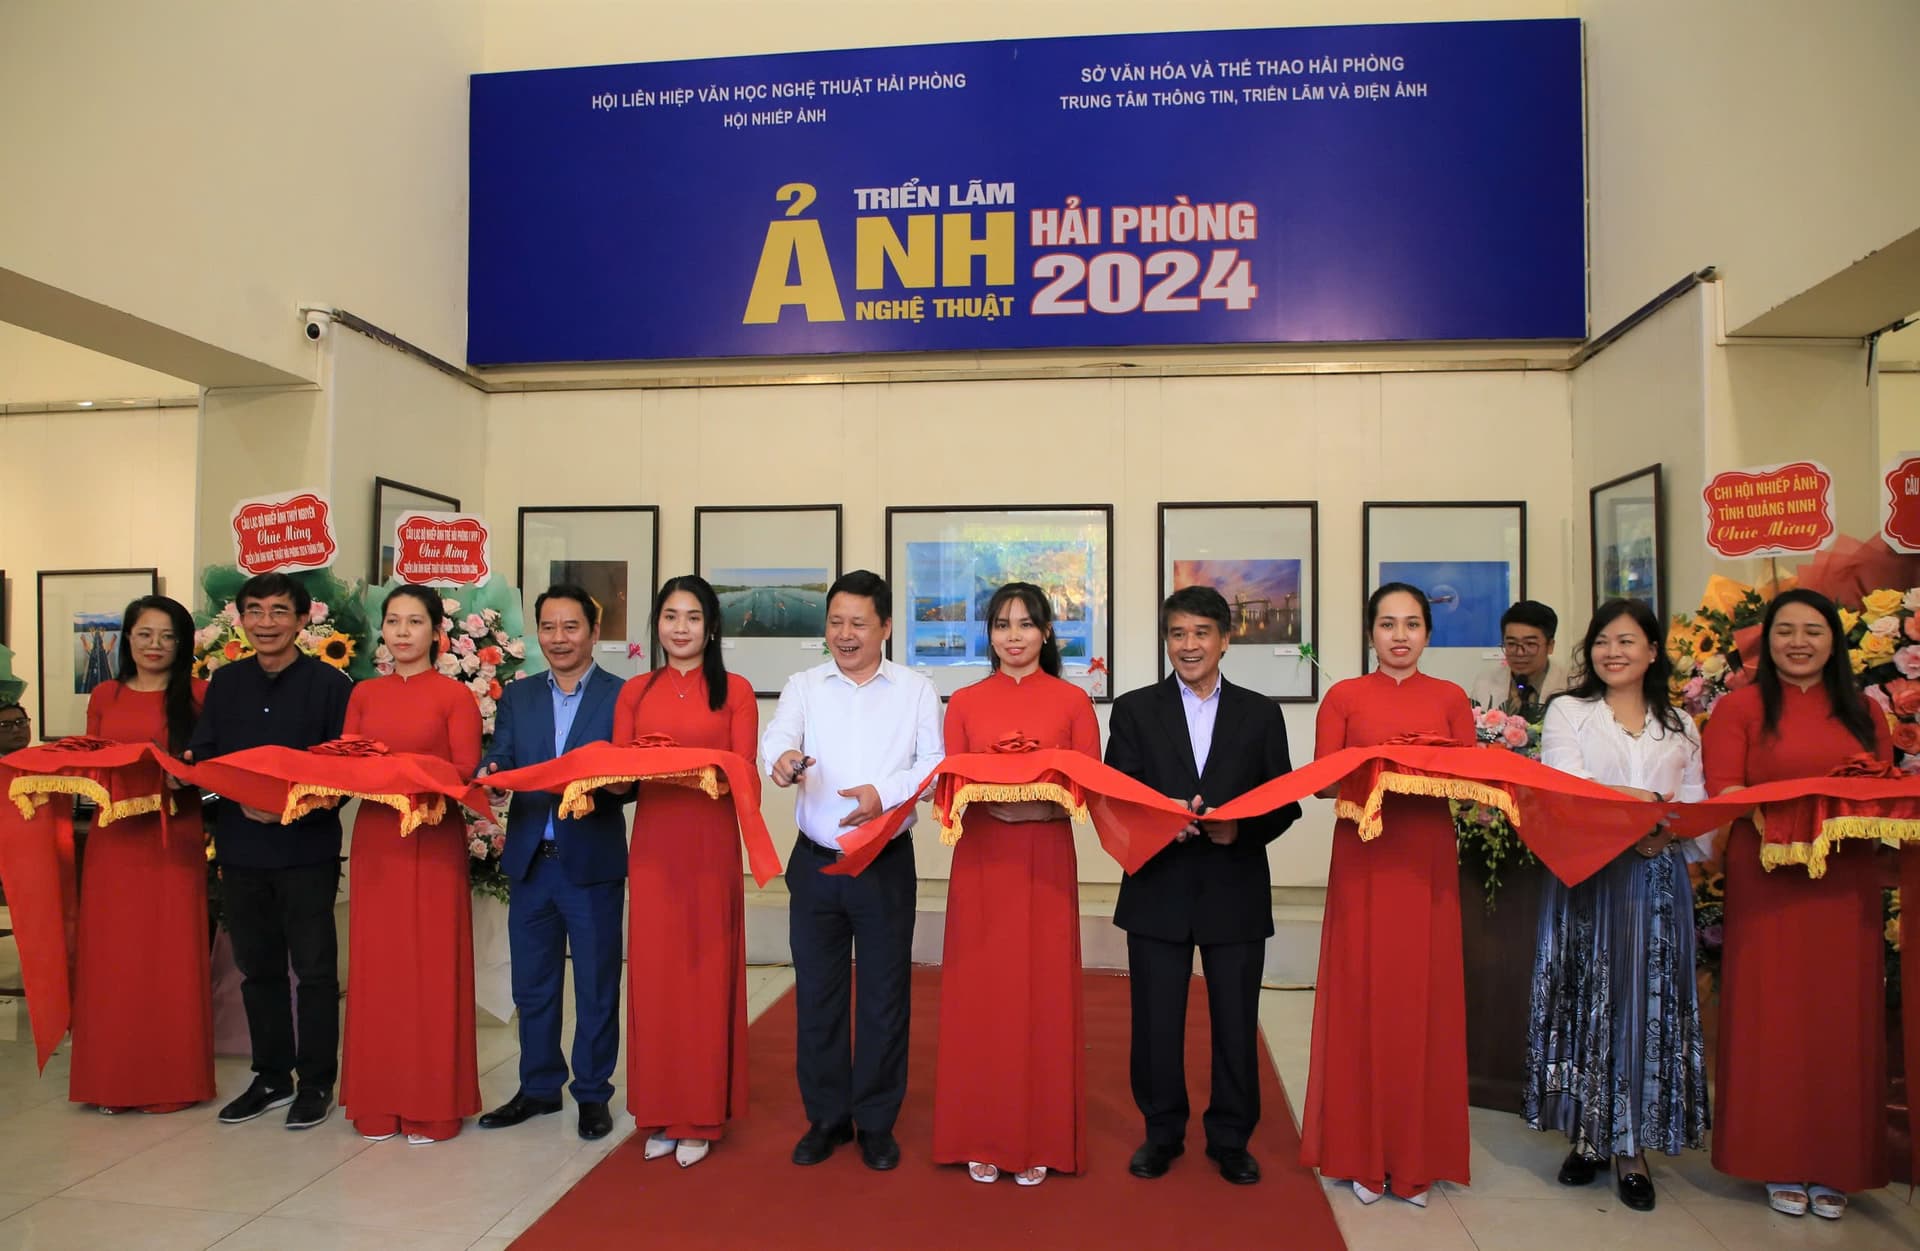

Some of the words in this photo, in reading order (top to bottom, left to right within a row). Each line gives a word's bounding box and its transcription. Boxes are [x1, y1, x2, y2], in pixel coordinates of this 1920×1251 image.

[1081, 65, 1106, 82] SỞ
[1110, 64, 1144, 81] VĂN
[1151, 61, 1186, 80] HÓA
[1191, 60, 1213, 78] VÀ
[1218, 59, 1251, 77] THỂ
[1256, 60, 1304, 75] THAO
[1309, 56, 1337, 73] HẢI
[1343, 54, 1404, 72] PHÒNG
[593, 93, 617, 111] HỘI
[623, 90, 654, 107] LIÊN
[660, 88, 694, 107] HIỆP
[698, 85, 729, 102] VĂN
[735, 85, 767, 102] HỌC
[772, 80, 815, 99] NGHỆ
[820, 77, 872, 96] THUẬT
[878, 74, 903, 92] HẢI
[909, 71, 966, 90] PHÒNG
[1060, 95, 1111, 109] TRUNG
[1116, 90, 1147, 107] TÂM
[1152, 89, 1205, 106] THÔNG
[1210, 90, 1237, 104] TIN,
[1243, 85, 1287, 102] TRIỂN
[1293, 84, 1324, 100] LÃM
[1328, 82, 1350, 99] VÀ
[1354, 83, 1389, 101] ĐIỆN
[1395, 81, 1427, 97] ẢNH
[724, 112, 747, 129] HỘI
[752, 109, 792, 125] NHIẾP
[797, 107, 826, 123] ẢNH
[854, 178, 939, 209] TRIỂN
[950, 180, 1014, 206] LÃM
[1031, 196, 1101, 246] HẢI
[1112, 195, 1257, 243] PHÒNG
[1031, 248, 1259, 314] 2024
[856, 296, 924, 323] NGHỆ
[933, 294, 1014, 320] THUẬT
[1714, 486, 1732, 500] CHI
[1735, 482, 1753, 499] HỘI
[1756, 475, 1790, 495] NHIẾP
[1793, 474, 1818, 491] ẢNH
[1905, 474, 1919, 495] CÂU
[1719, 503, 1744, 520] TỈNH
[1747, 500, 1784, 518] QUẢNG
[1788, 499, 1817, 514] NINH
[258, 529, 281, 545] Chúc
[284, 525, 311, 542] Mừng
[1717, 525, 1758, 541] Chúc
[1763, 520, 1817, 537] Mừng
[419, 543, 440, 558] Chúc
[442, 544, 468, 561] Mừng
